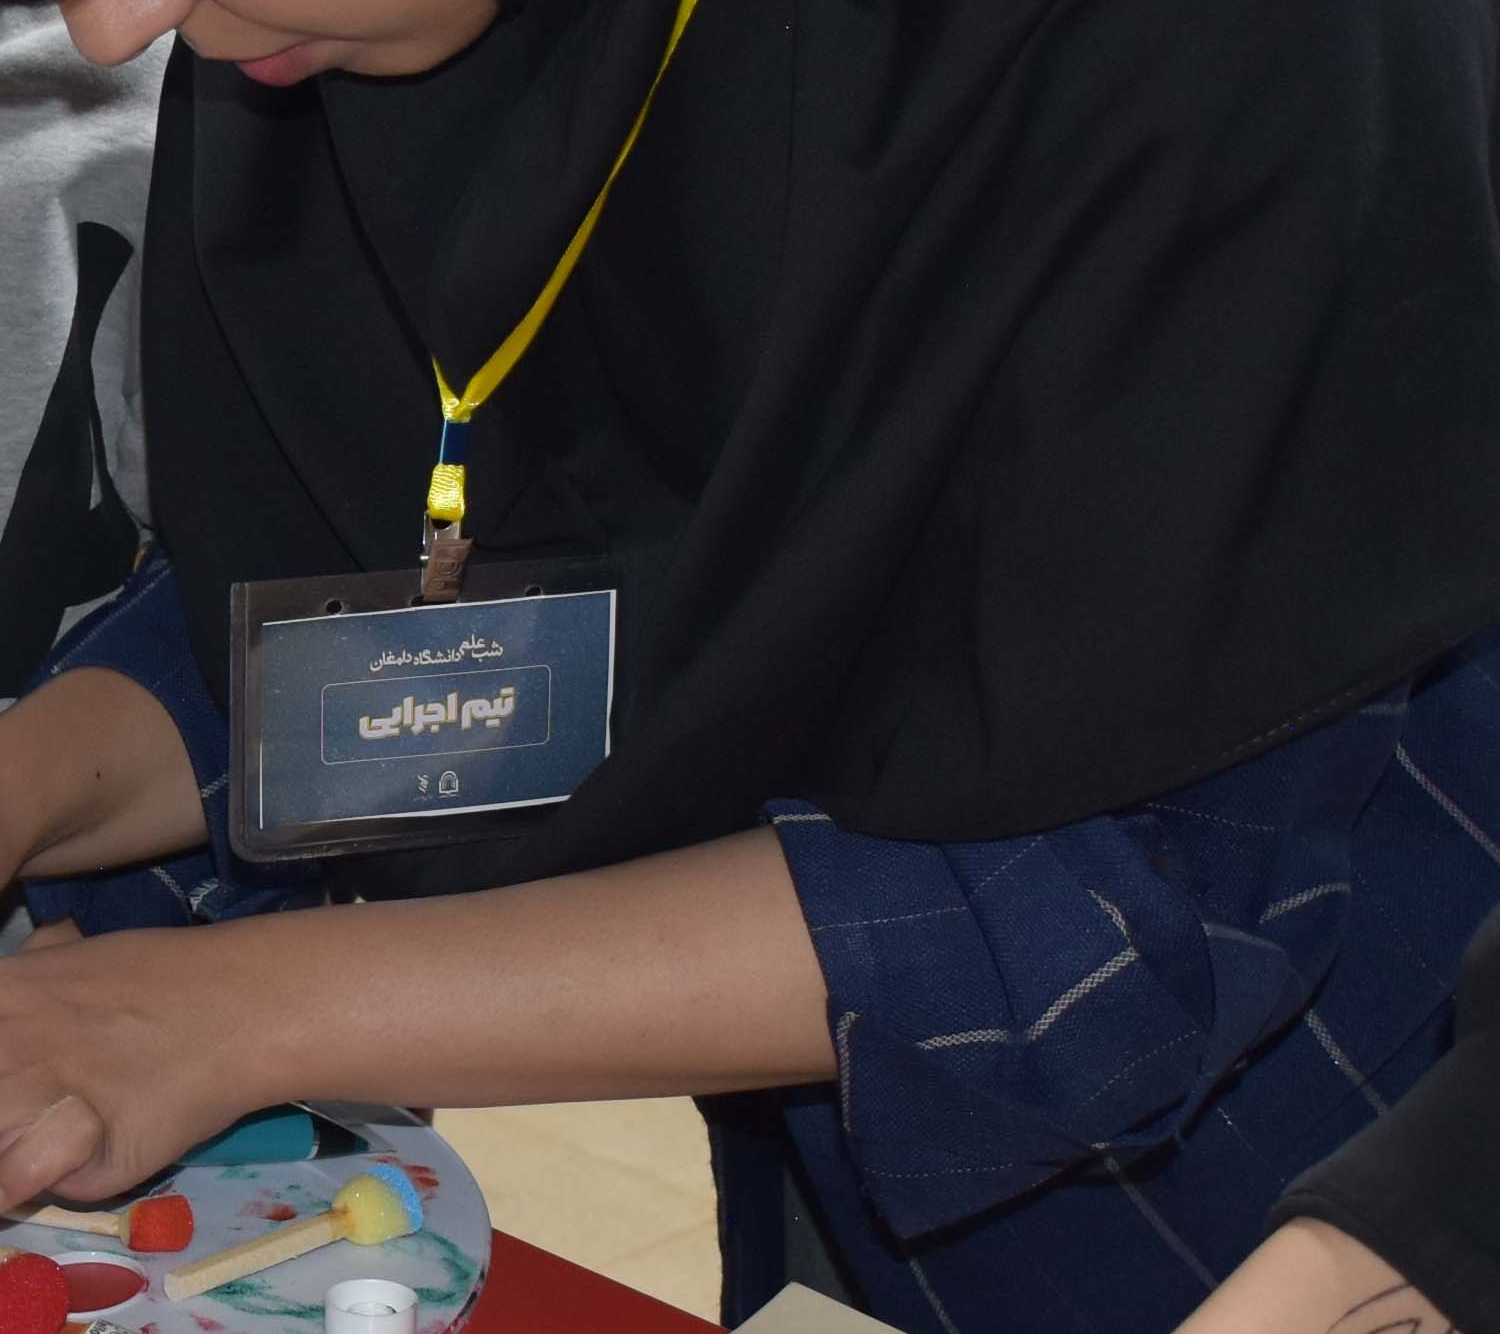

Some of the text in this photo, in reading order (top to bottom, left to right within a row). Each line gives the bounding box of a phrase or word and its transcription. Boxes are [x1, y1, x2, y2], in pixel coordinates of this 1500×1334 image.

[369, 648, 462, 672] دانشگاه دامغان
[458, 632, 504, 663] شب علم
[358, 686, 516, 740] تیم اجرایی
